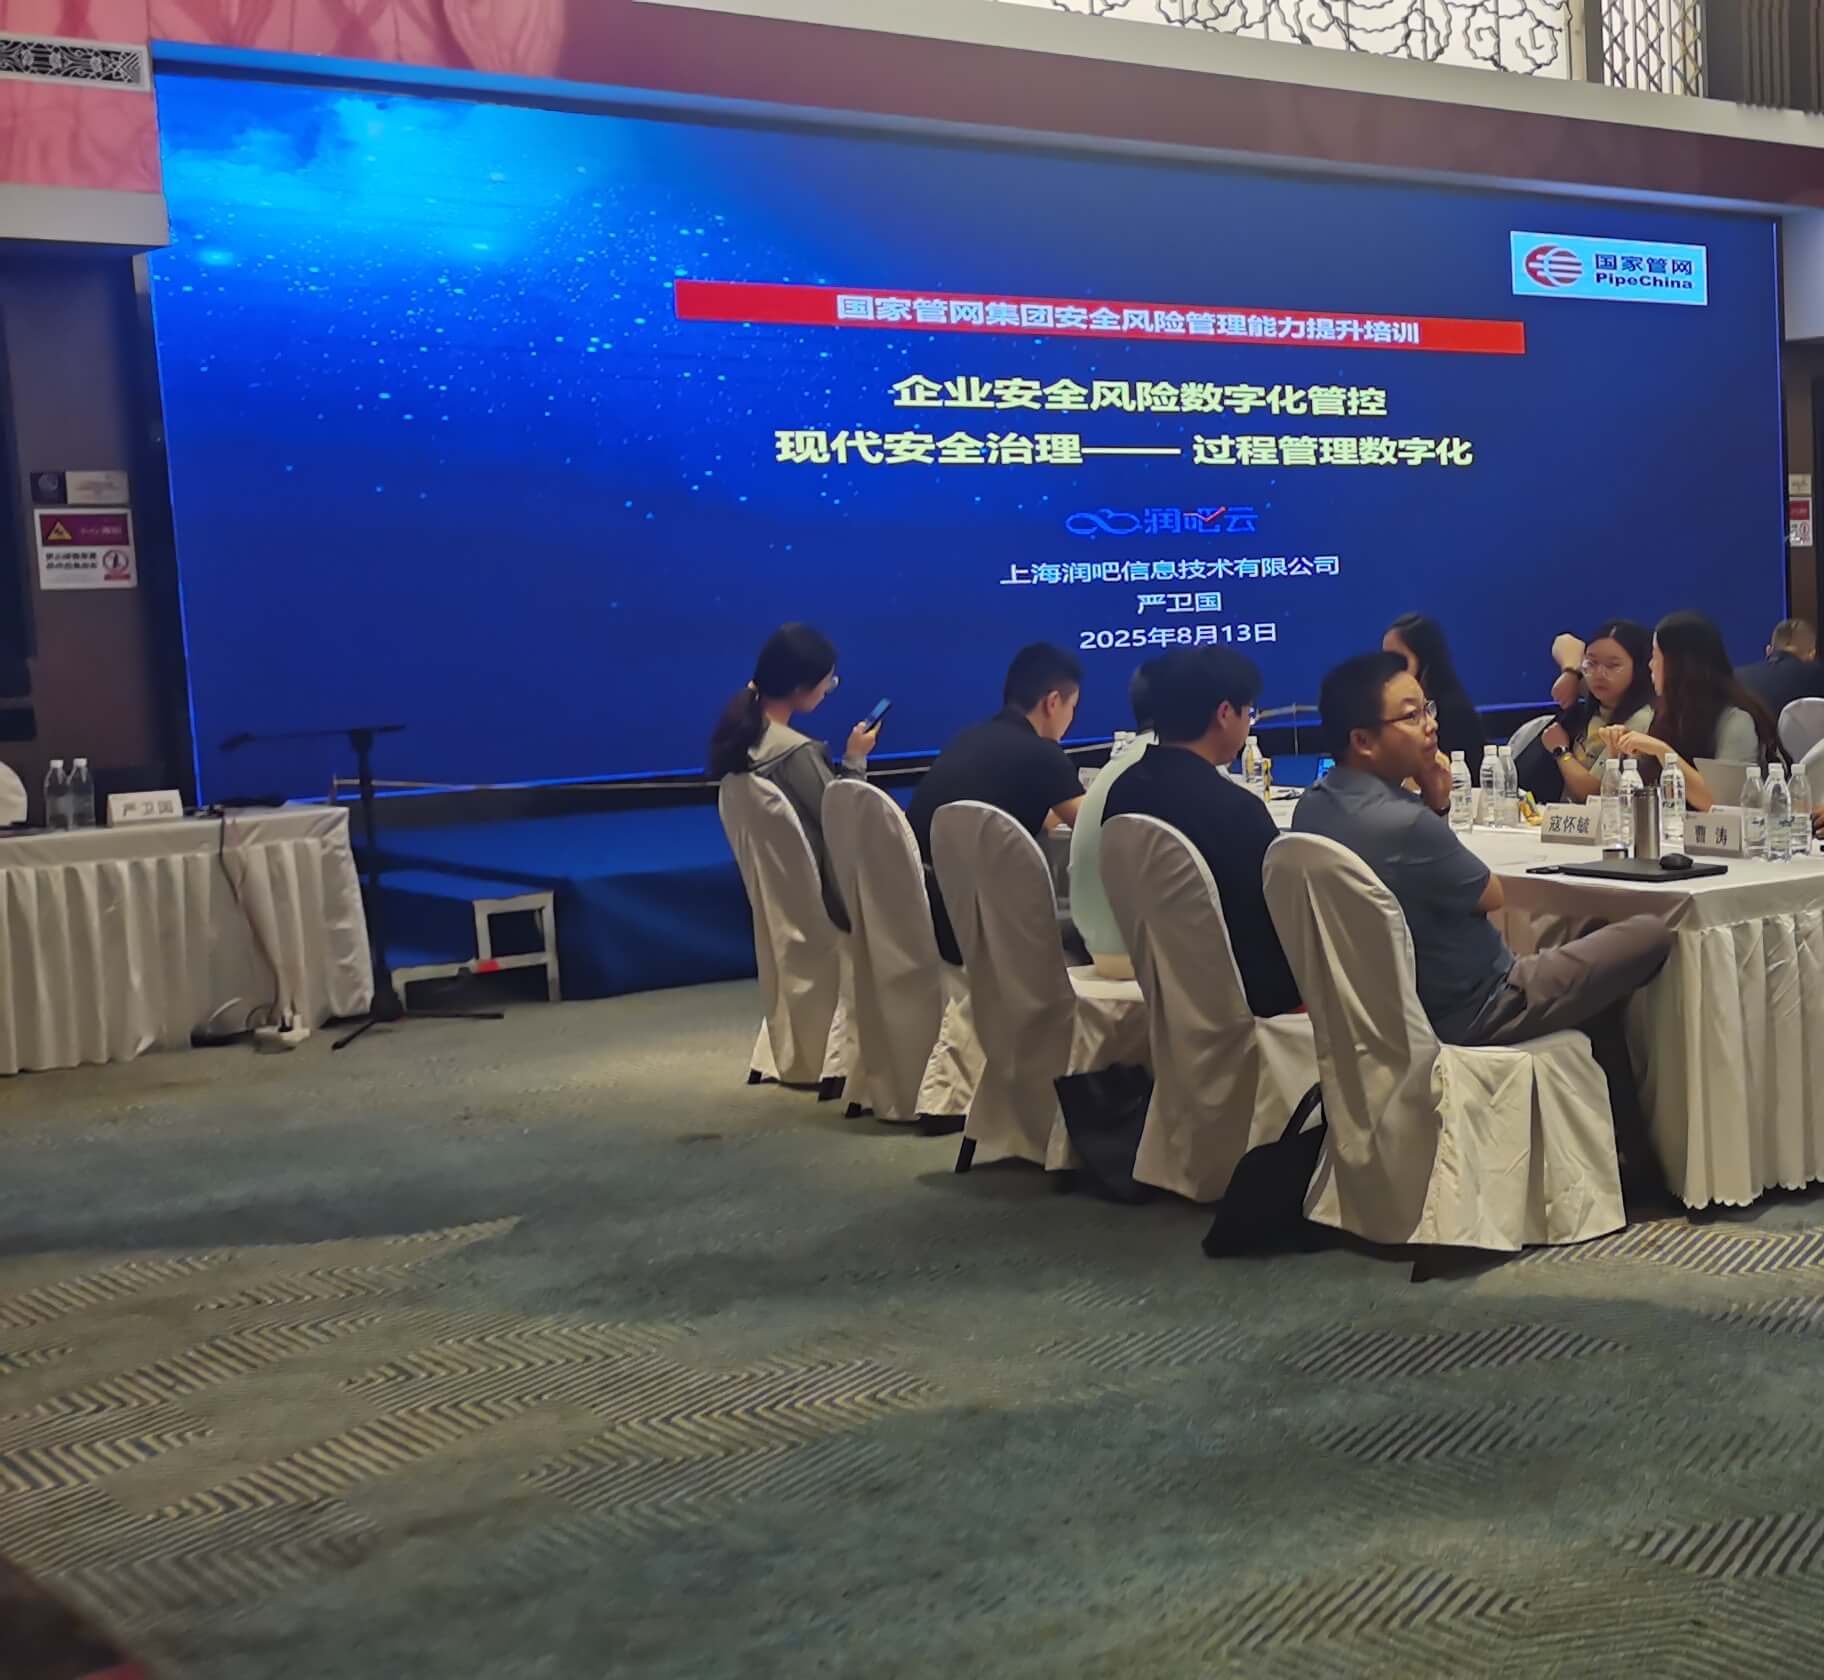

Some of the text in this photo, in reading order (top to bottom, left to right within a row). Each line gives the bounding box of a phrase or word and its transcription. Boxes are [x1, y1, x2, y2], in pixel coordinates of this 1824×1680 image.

[1594, 253, 1693, 275] 国家管网
[1596, 272, 1692, 289] PipeChina
[837, 294, 1420, 344] 国家管网集团安全风险管理能力提升培训
[893, 374, 1388, 416] 企业安全风险数字化管控
[1144, 506, 1258, 534] 润吧云
[1000, 555, 1340, 585] 上海润吧信息技术有限公司
[1136, 591, 1222, 614] 严卫国
[1079, 622, 1277, 650] 2025年8月13日
